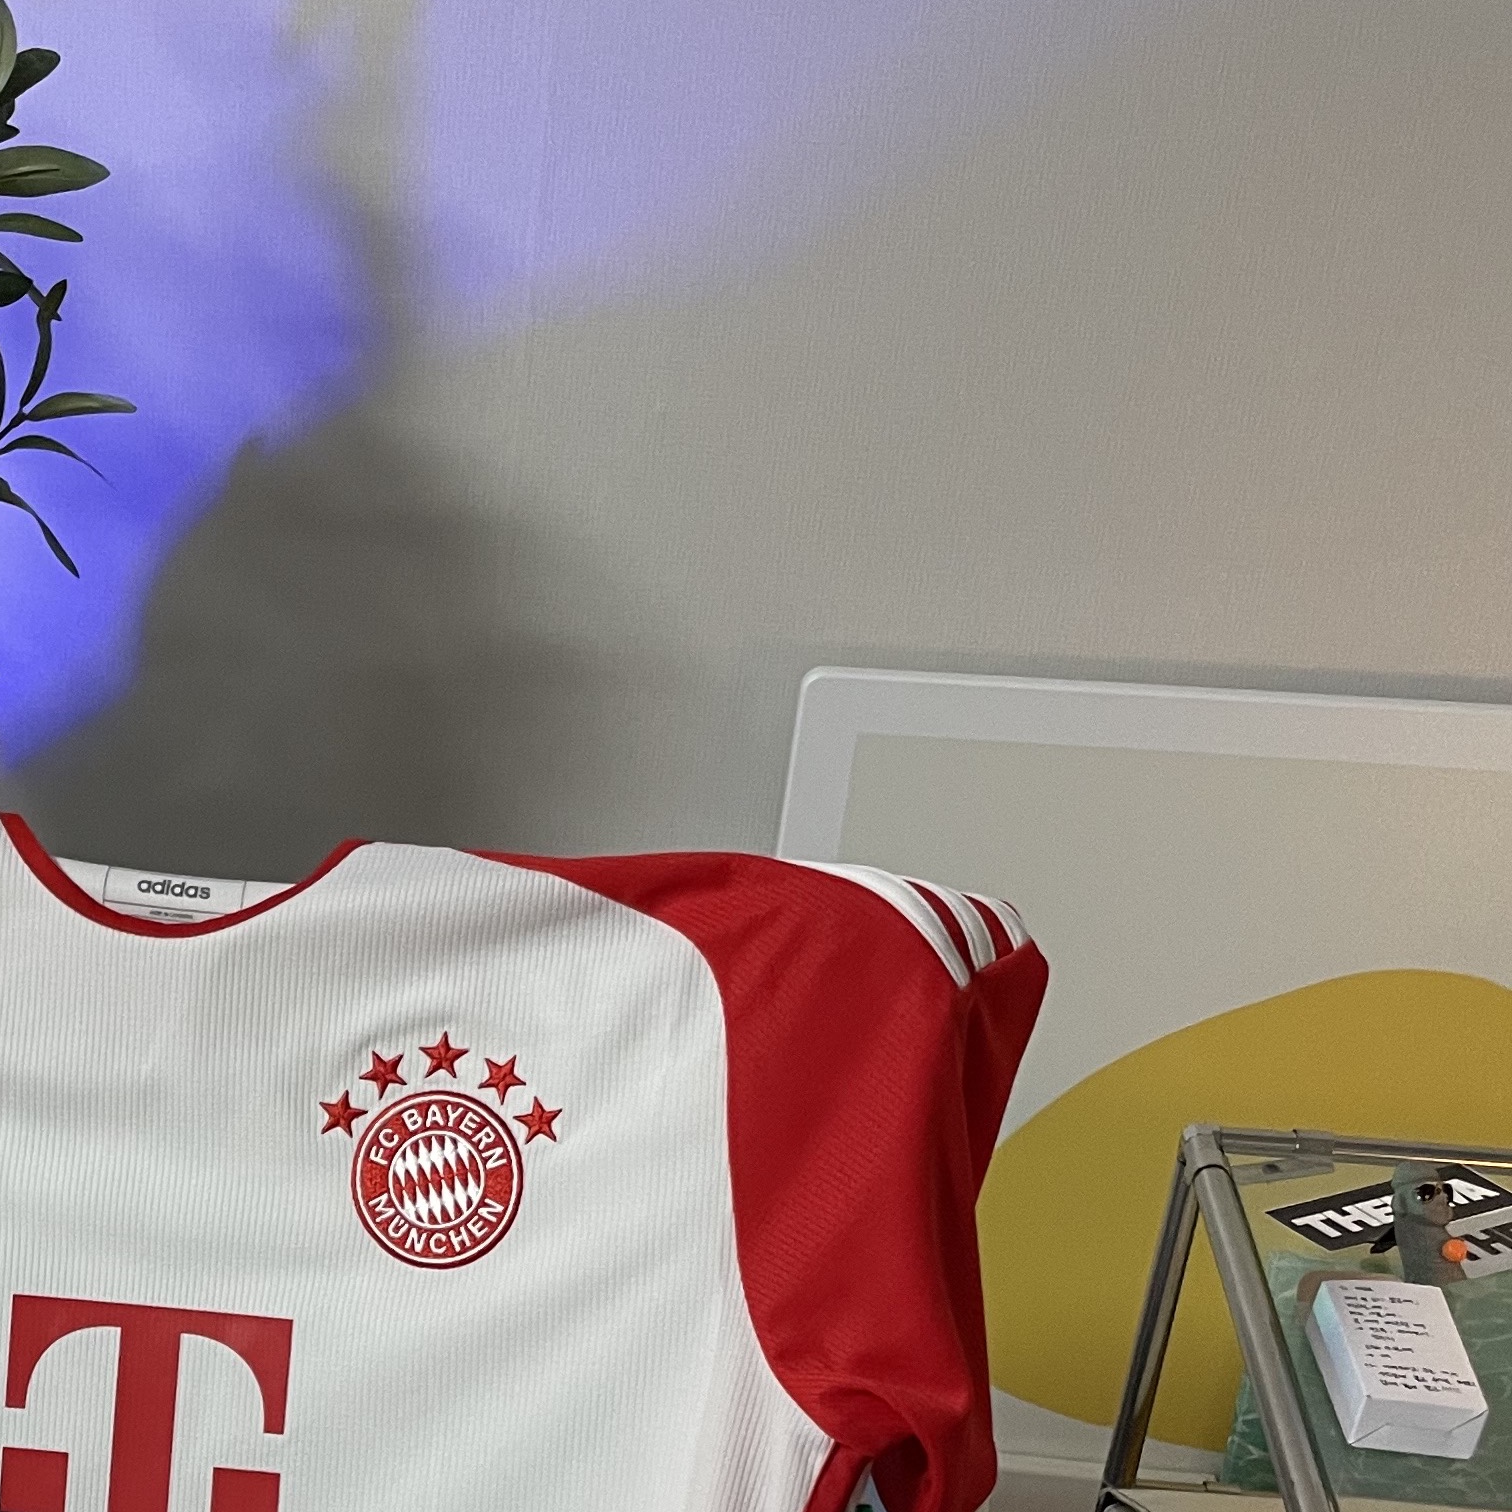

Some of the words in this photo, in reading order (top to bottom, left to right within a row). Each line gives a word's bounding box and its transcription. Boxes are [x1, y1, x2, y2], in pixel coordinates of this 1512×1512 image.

[137, 877, 211, 900] adidas
[368, 1127, 400, 1167] FC
[402, 1103, 507, 1169] BAYERN
[368, 1191, 505, 1255] MÜNCHEN
